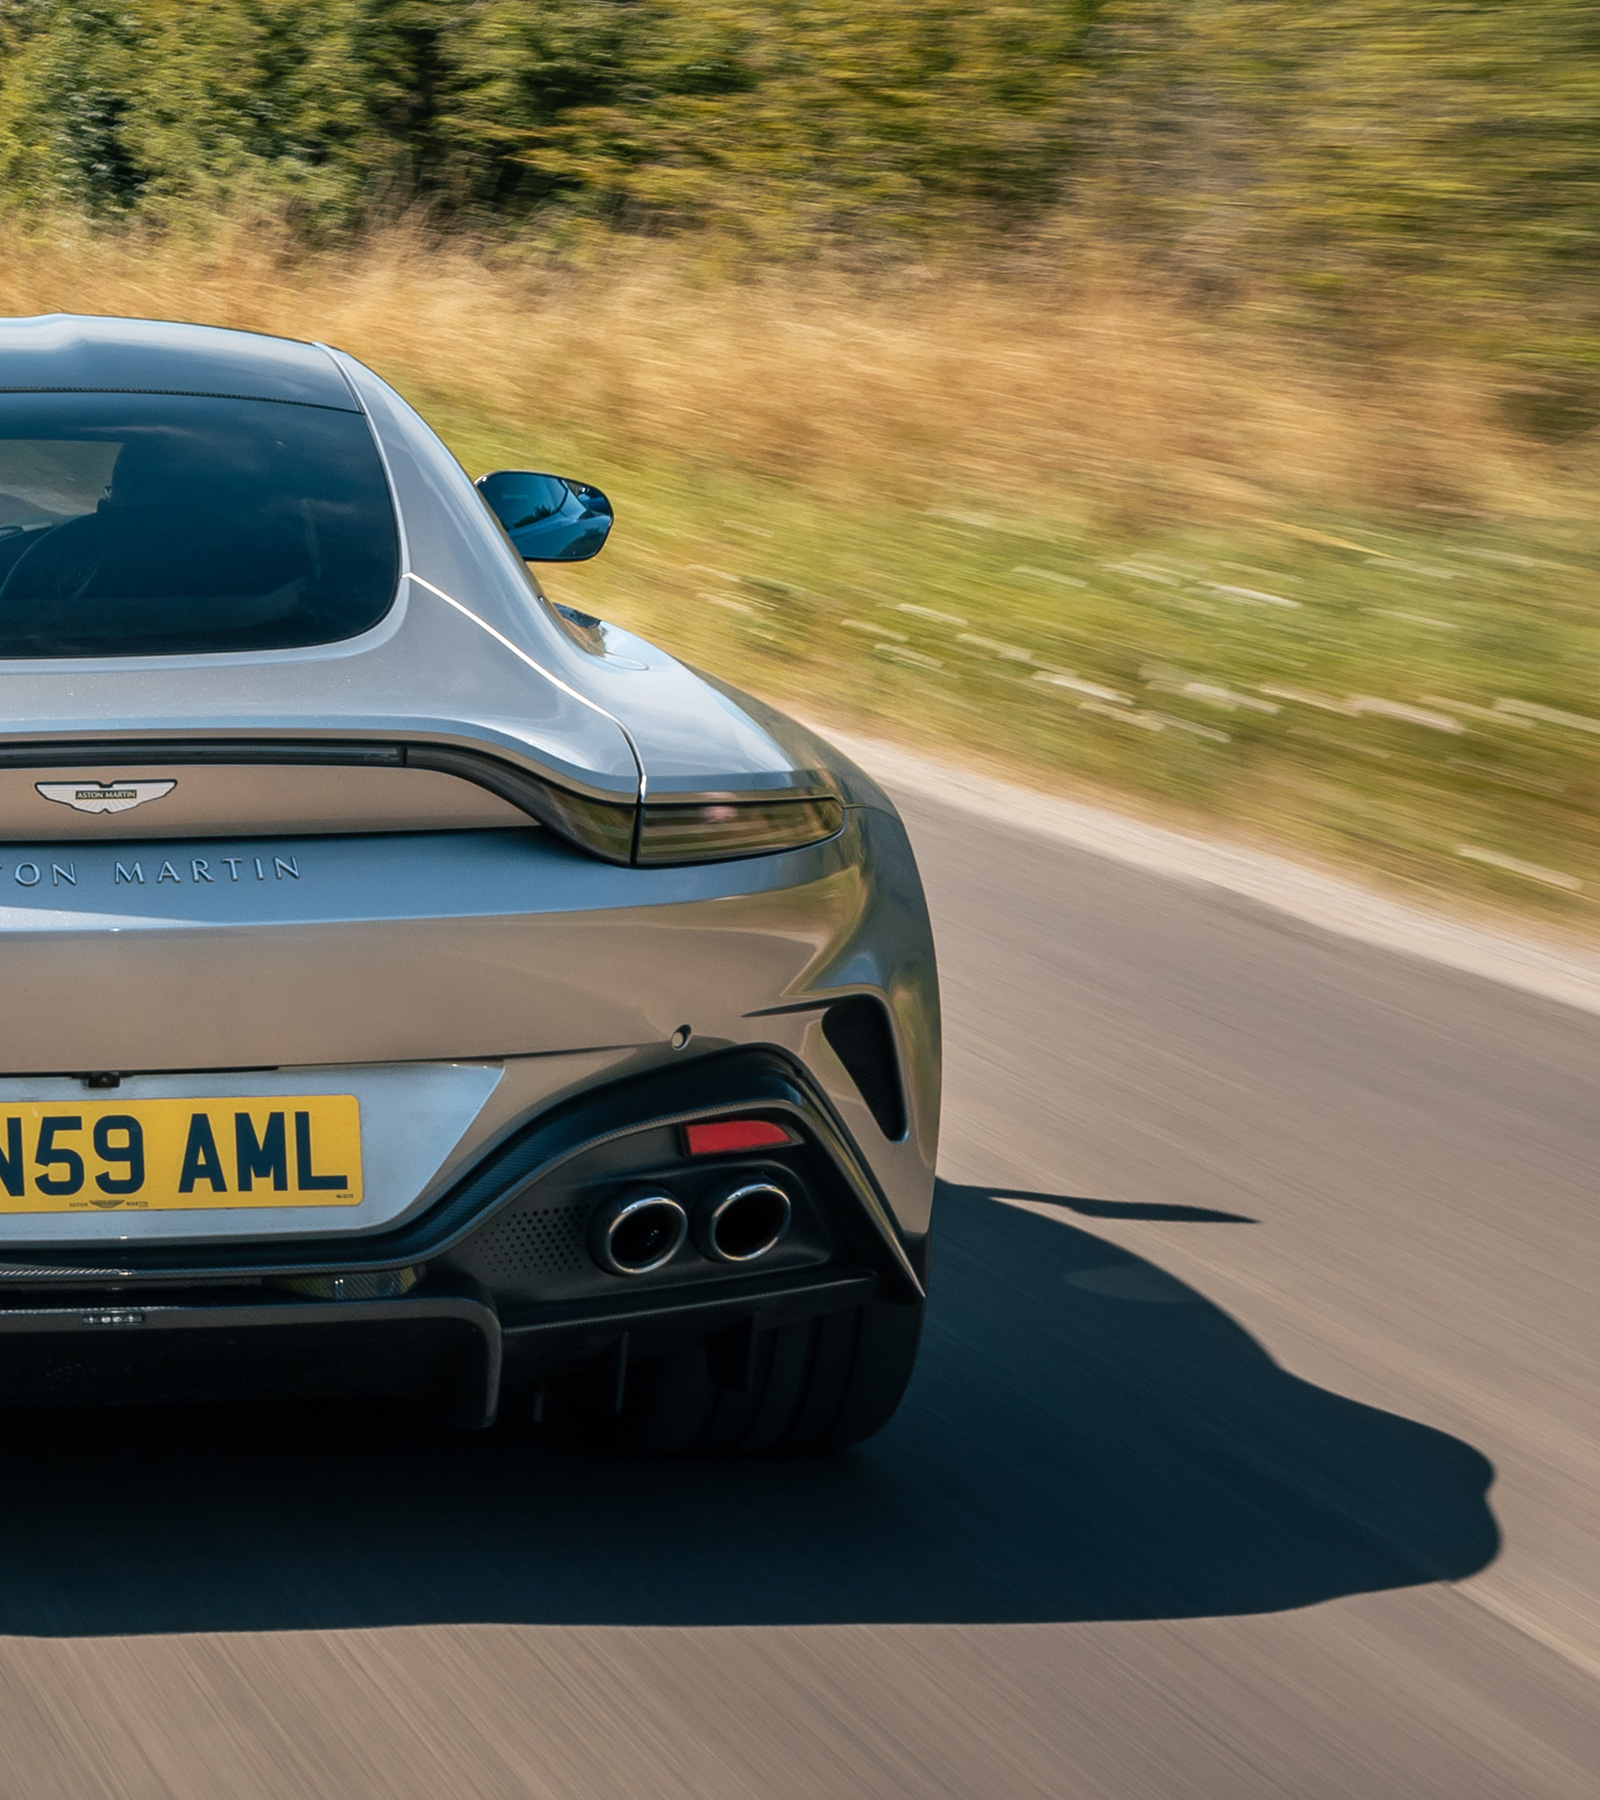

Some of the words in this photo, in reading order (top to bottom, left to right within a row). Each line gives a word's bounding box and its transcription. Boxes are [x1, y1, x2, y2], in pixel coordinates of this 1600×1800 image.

[77, 791, 103, 799] ASTON
[105, 790, 136, 798] MARTIN
[114, 856, 300, 884] MARTIN
[178, 1111, 348, 1193] AML
